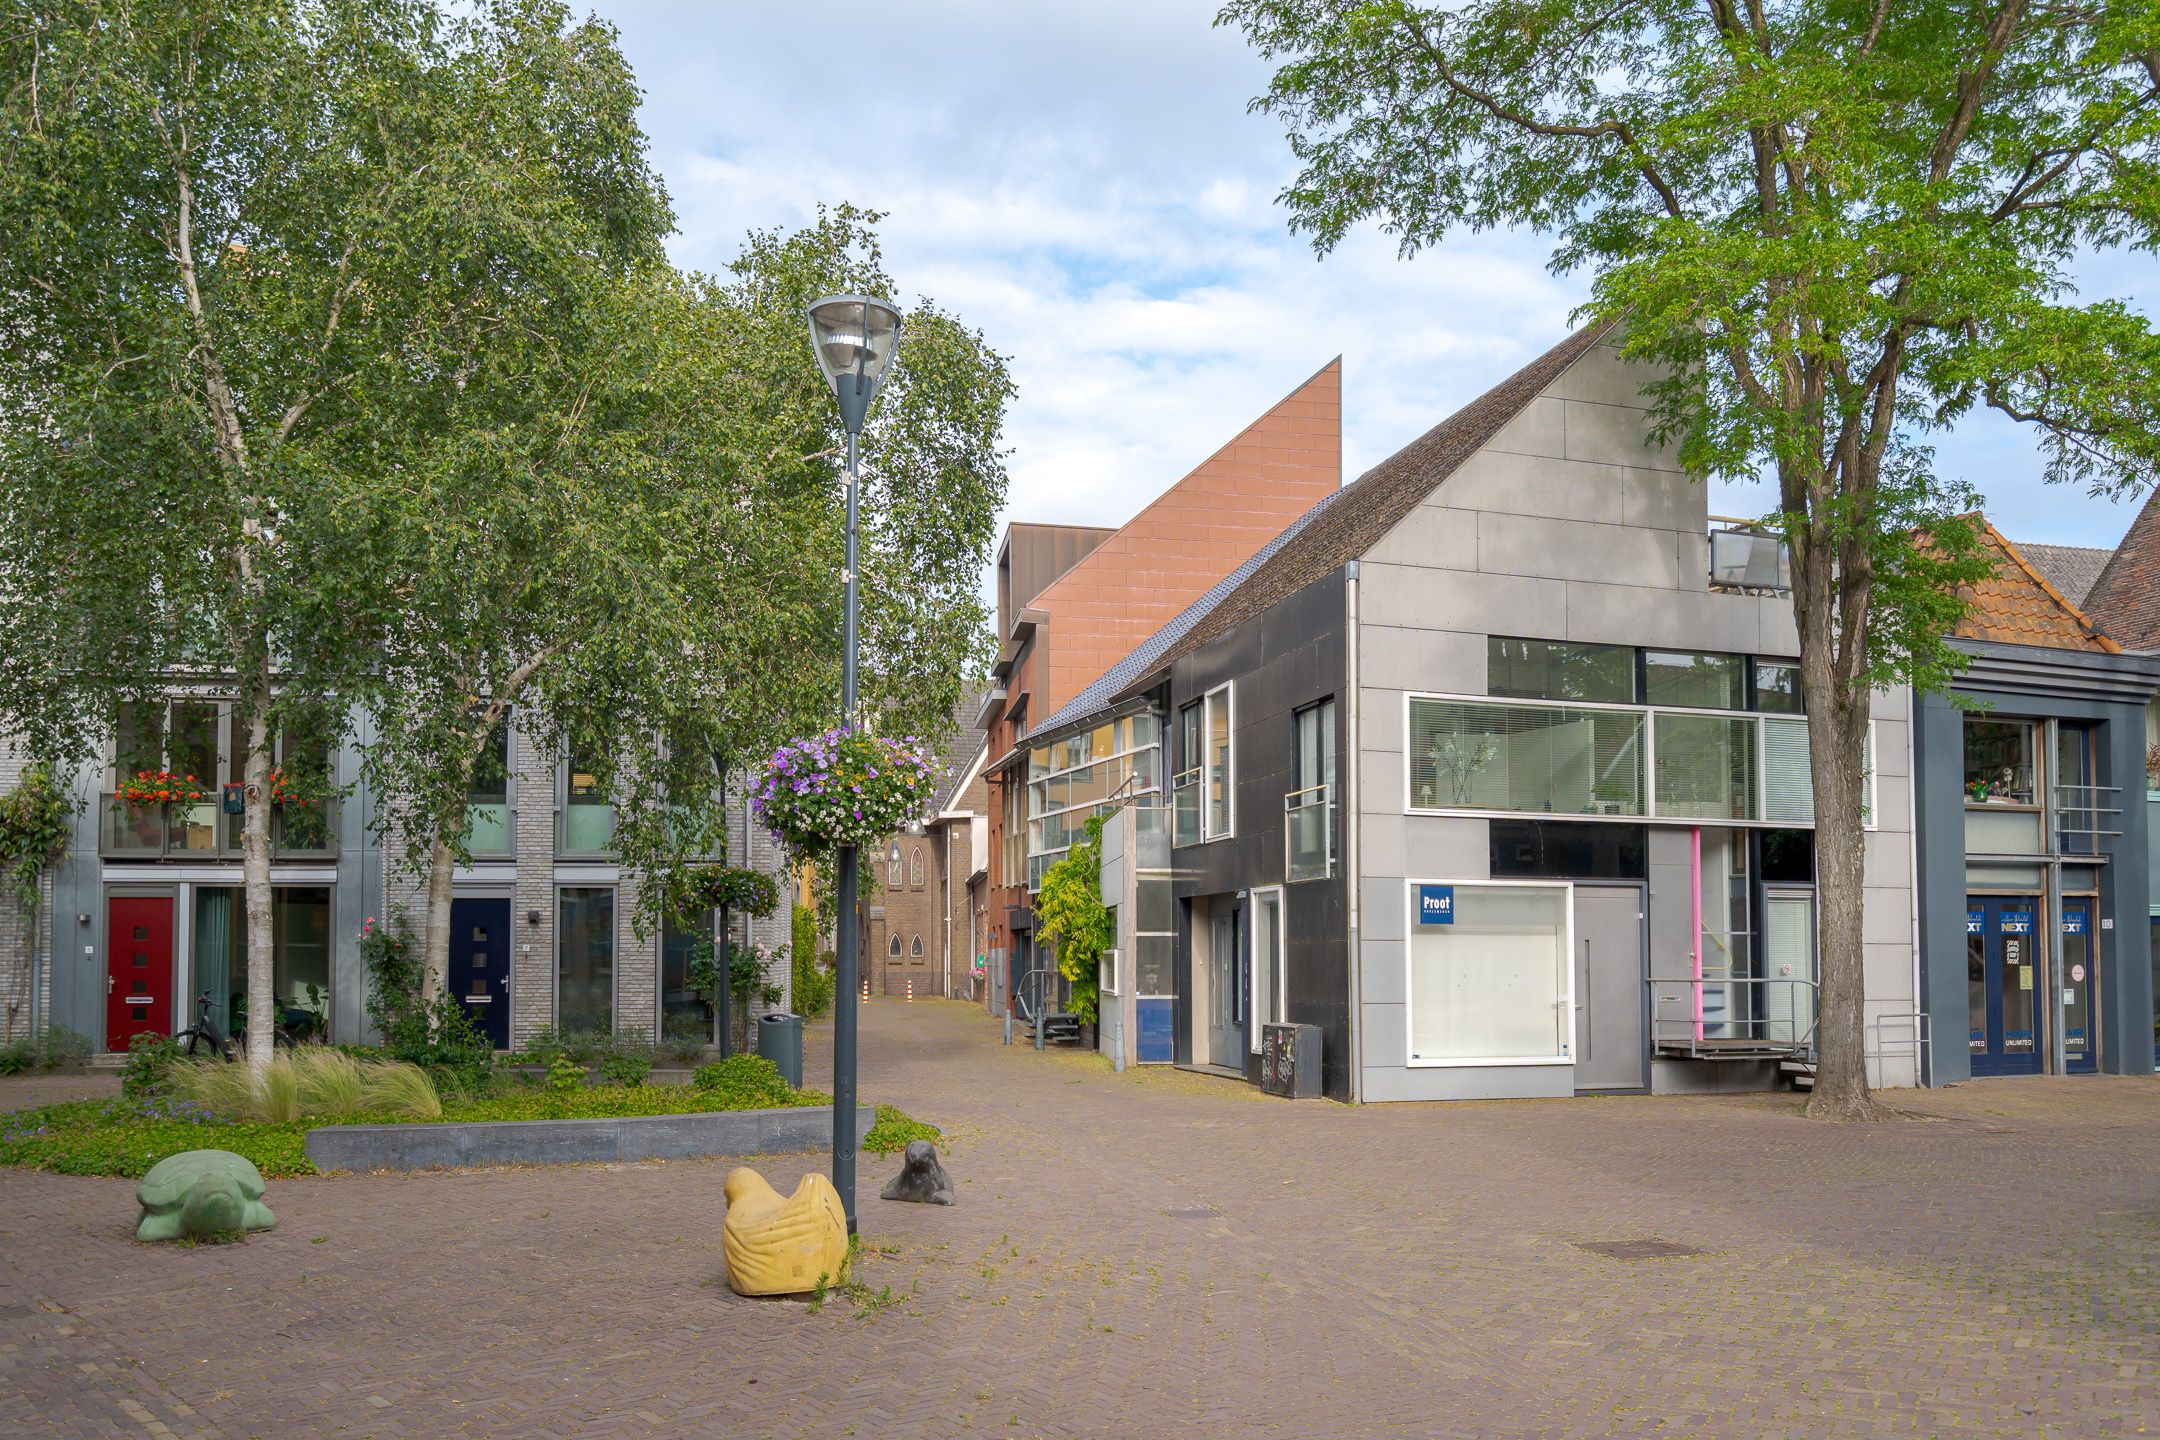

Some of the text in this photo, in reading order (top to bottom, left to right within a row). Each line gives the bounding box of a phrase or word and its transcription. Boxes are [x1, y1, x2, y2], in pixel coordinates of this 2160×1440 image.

[1423, 896, 1450, 909] Proot
[1967, 922, 1982, 932] XT
[2001, 922, 2029, 932] NEXT
[2062, 923, 2082, 933] EXT
[2102, 920, 2112, 928] 10
[2065, 1028, 2083, 1037] AIR
